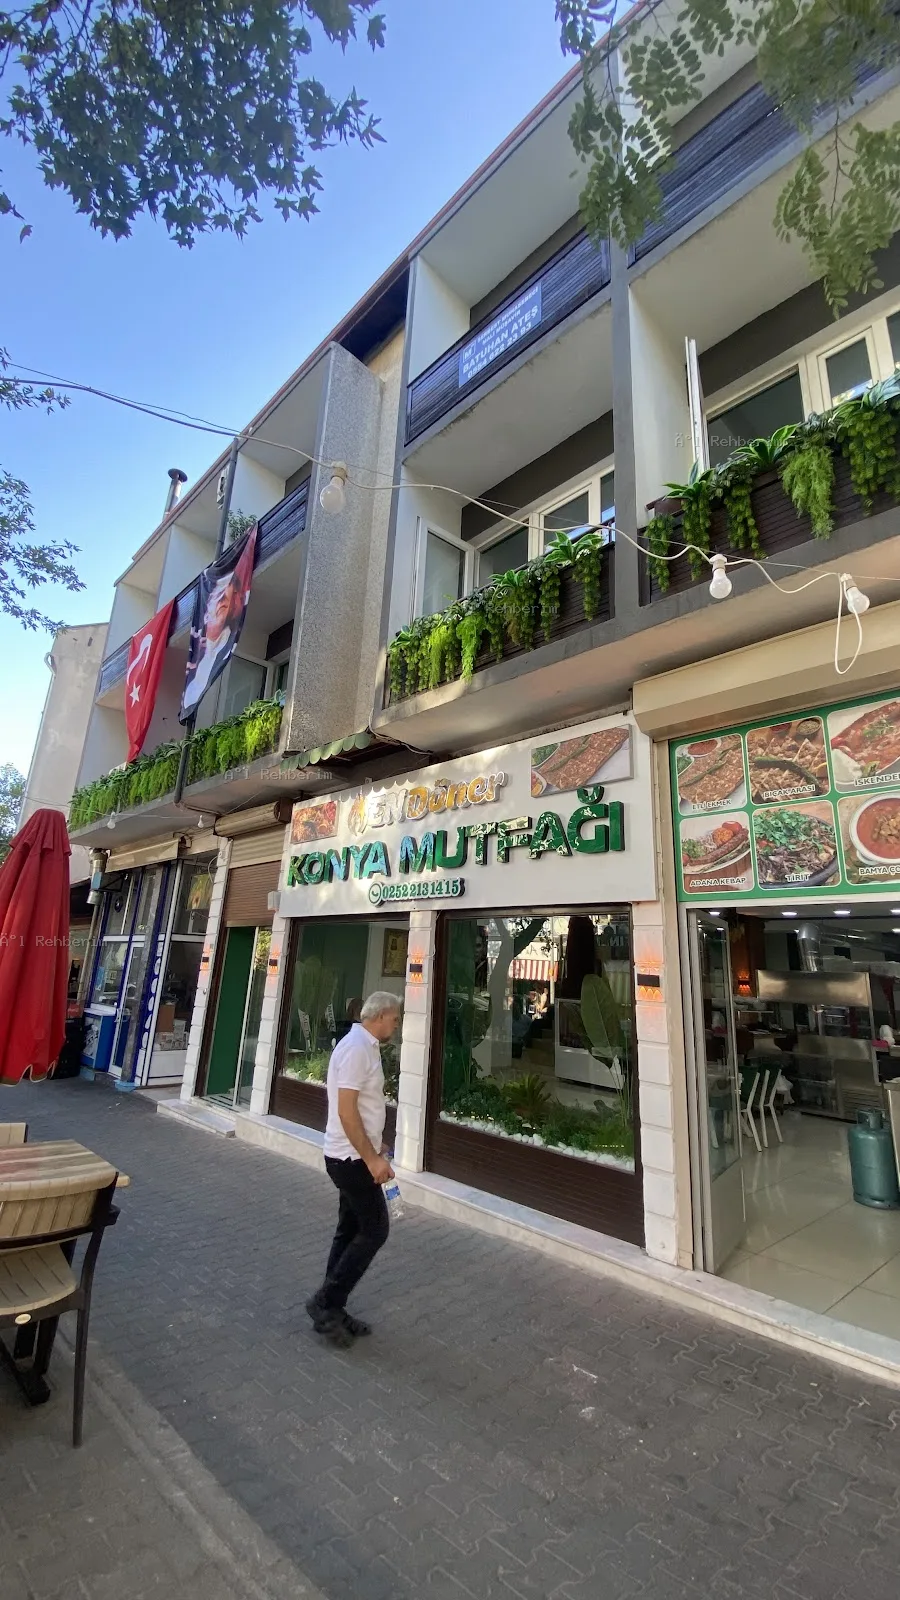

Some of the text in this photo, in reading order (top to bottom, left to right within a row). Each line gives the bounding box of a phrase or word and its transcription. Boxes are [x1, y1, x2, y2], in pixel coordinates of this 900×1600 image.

[463, 305, 538, 373] BATUHAN ATEŞ
[790, 784, 815, 793] ARASI
[406, 771, 505, 820] Döner
[707, 799, 731, 808] EKMEK
[287, 785, 625, 887] KONYA MUTFAĞI
[859, 867, 887, 875] BAMYA
[690, 877, 746, 887] ADANA KEBAP
[785, 873, 810, 882] TİRİT
